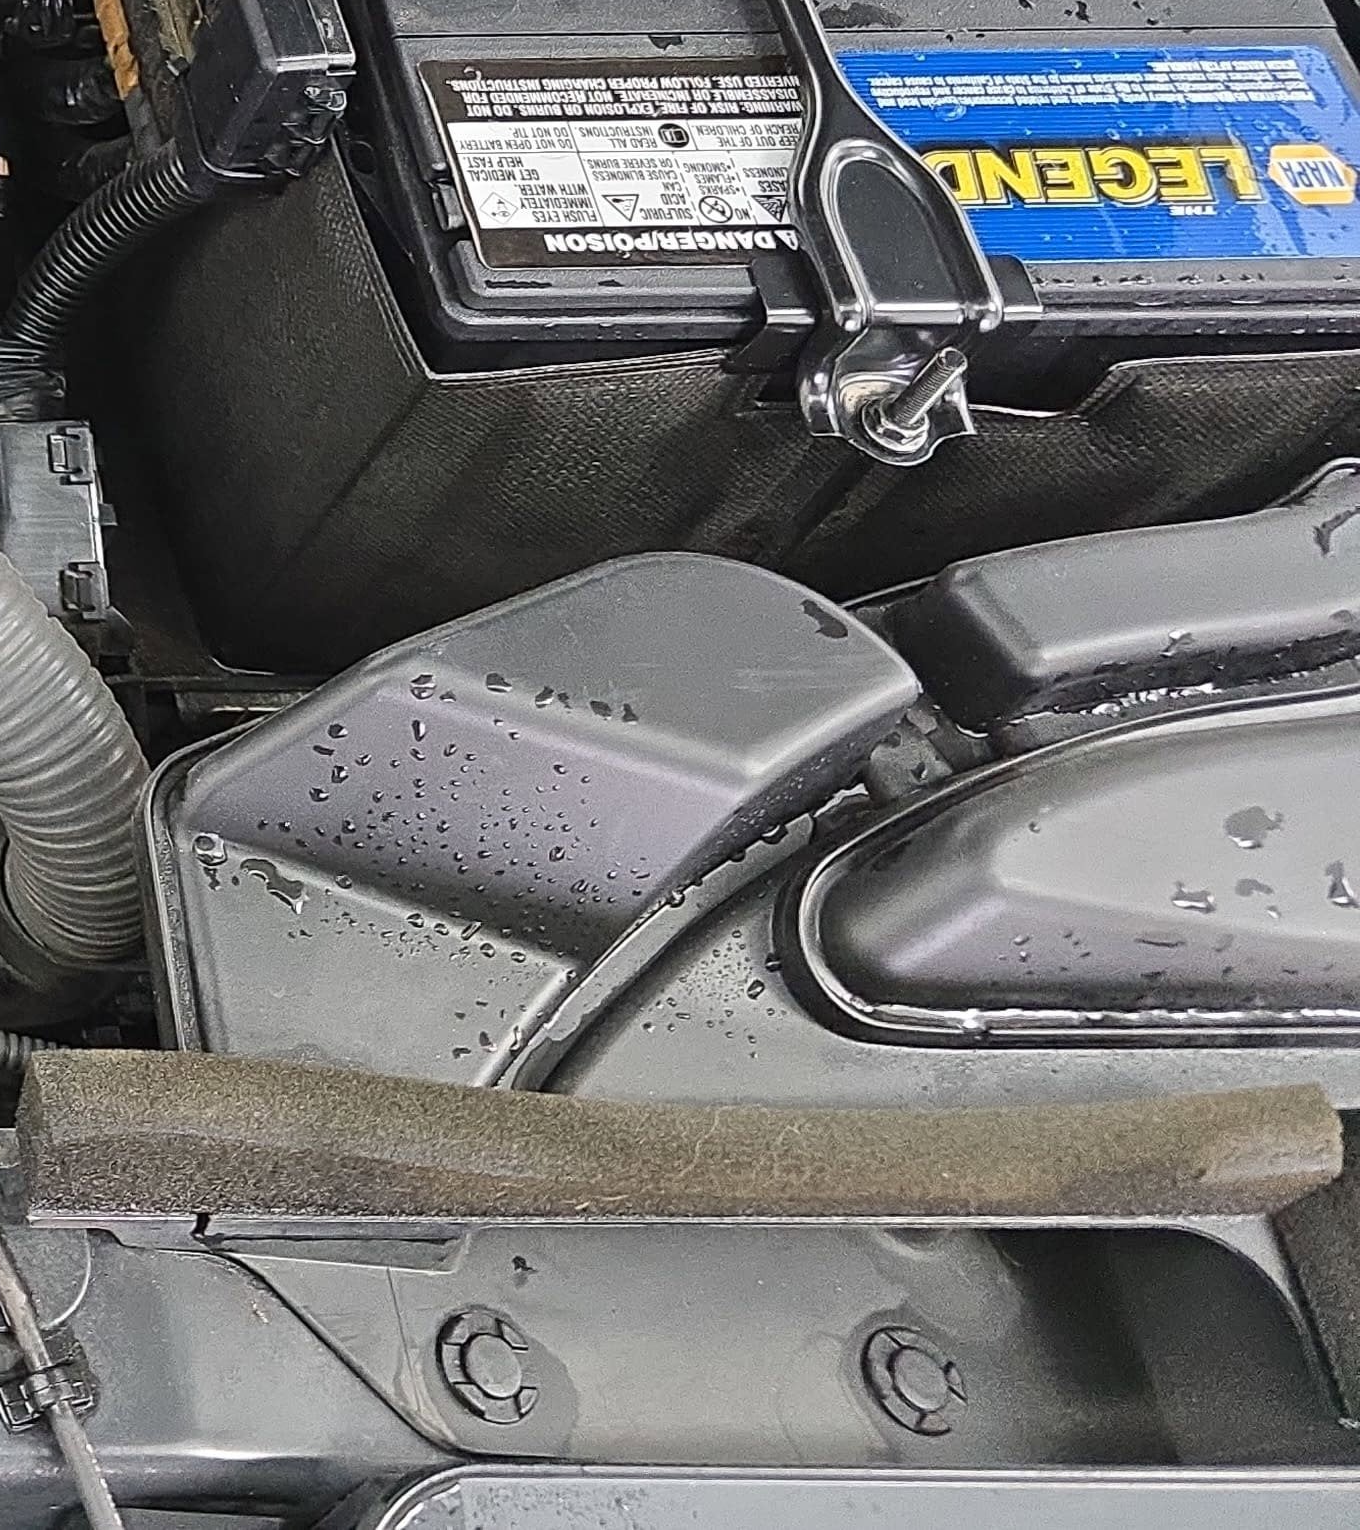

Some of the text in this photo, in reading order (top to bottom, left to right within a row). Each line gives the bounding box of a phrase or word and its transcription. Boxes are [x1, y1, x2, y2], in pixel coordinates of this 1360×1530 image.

[446, 75, 799, 91] NVERTED USE. FOLLOW PROPER CHARGING INSTRUCTIONS.
[462, 88, 796, 103] DISASSEMBLE OR INCINERATE. NOT RECOMMENDED FOR
[467, 101, 801, 117] WARNING: RISK OF FIRE, EXPLOSION OR BURNS. DO NOT
[509, 127, 568, 138] DO NOT TIP.
[575, 126, 653, 138] INSTRUCTIONS.
[692, 124, 797, 137] REACH OF CHILDREN.
[456, 138, 573, 151] DO NOT OPEN BATTERY.
[610, 138, 657, 148] READ ALL
[716, 135, 799, 148] EEP OUT OF THE
[463, 156, 523, 169] HELP FAST.
[584, 158, 673, 169] OR SEVERE BURNS.
[467, 169, 539, 181] GET MEDICAL
[592, 169, 677, 181] CAUSE BLINDNESS
[920, 146, 1263, 206] LEGEND
[1279, 161, 1345, 187] NAPA
[515, 183, 588, 196] WITH WATER.
[662, 182, 681, 192] CAN
[758, 181, 786, 192] ASES
[520, 197, 591, 209] IMMEDIATELY
[660, 193, 686, 204] ACID
[532, 210, 596, 222] FLUSH EYES
[640, 208, 693, 220] SULFURIC
[735, 208, 750, 220] NO
[1170, 206, 1216, 215] THE
[544, 230, 775, 252] DANGER/POISON
